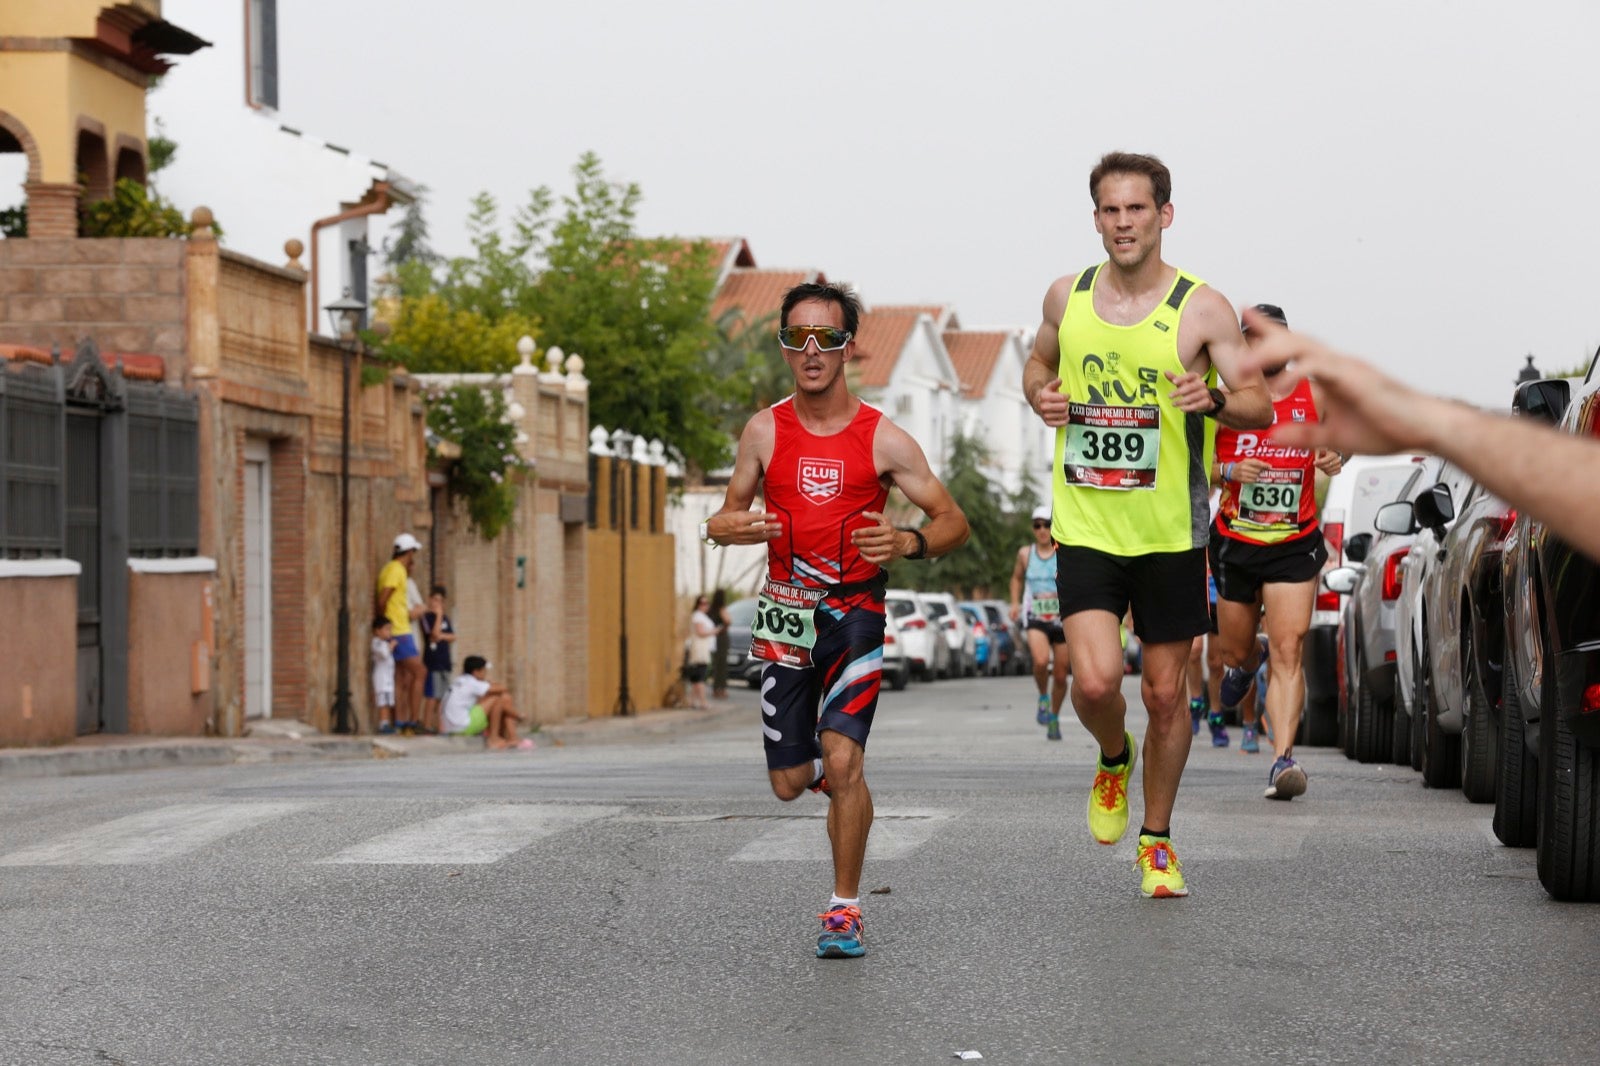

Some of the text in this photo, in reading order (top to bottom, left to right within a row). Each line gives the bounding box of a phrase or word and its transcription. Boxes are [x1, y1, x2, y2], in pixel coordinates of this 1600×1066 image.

[1085, 407, 1100, 418] GRAN
[1102, 408, 1125, 418] PREMIO
[1126, 409, 1133, 418] DE
[1135, 409, 1155, 419] FONDO
[1082, 430, 1145, 462] 389
[802, 466, 839, 480] CLUB
[1252, 486, 1295, 508] 630
[769, 583, 790, 598] PREMIO
[790, 587, 799, 599] DE
